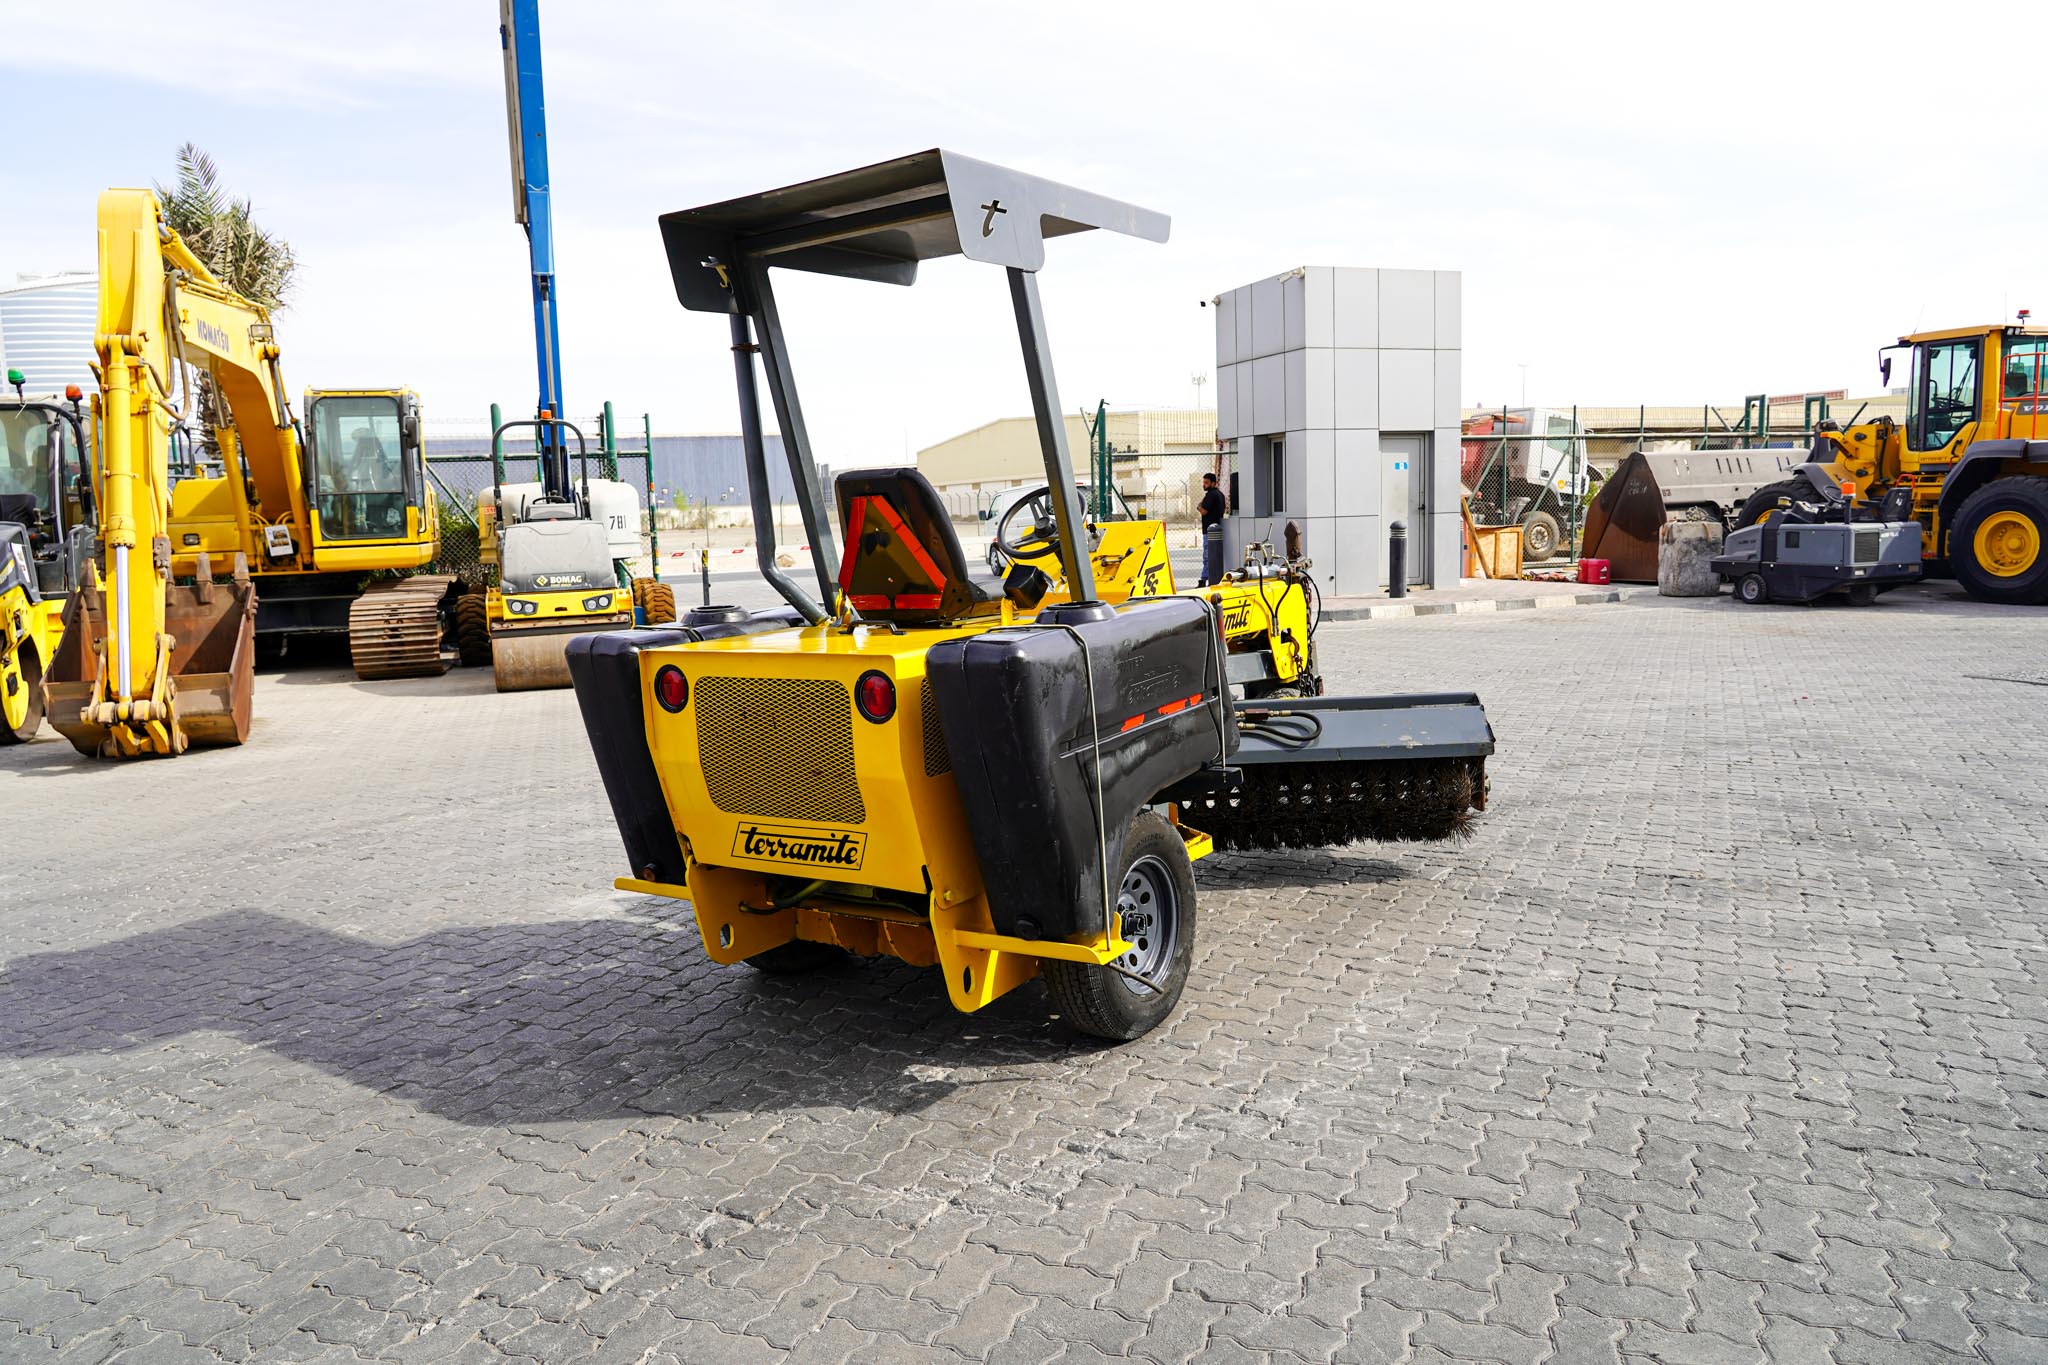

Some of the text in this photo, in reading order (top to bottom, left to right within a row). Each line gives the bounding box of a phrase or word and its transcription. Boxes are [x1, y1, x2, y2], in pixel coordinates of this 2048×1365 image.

[196, 317, 230, 353] KOMATSU
[609, 514, 627, 530] 781
[550, 575, 583, 584] BOMAG
[740, 826, 860, 865] terramite
